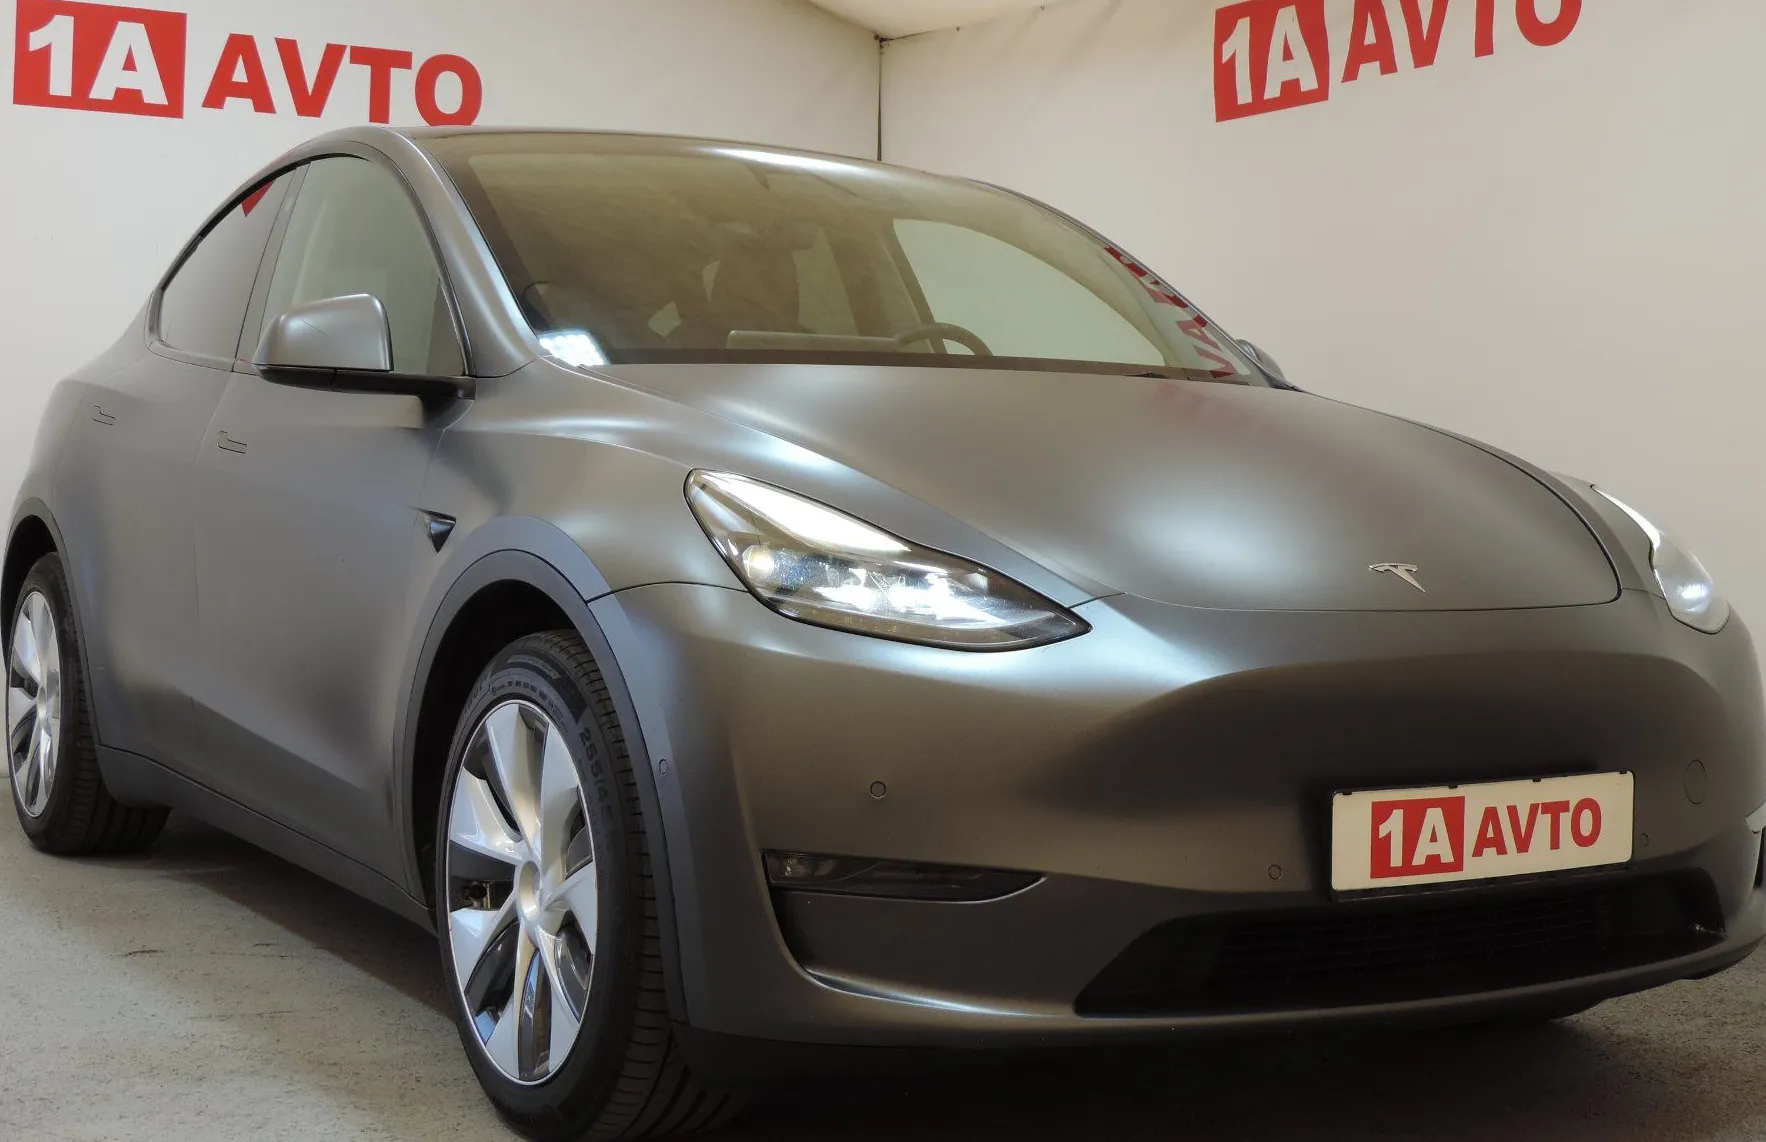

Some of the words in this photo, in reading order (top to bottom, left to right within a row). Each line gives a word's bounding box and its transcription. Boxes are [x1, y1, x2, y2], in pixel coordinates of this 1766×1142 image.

[29, 15, 168, 104] 1A
[203, 33, 482, 127] AVTO
[1222, 5, 1319, 105] 1A
[1378, 807, 1455, 868] 1A
[1472, 797, 1602, 858] AVTO
